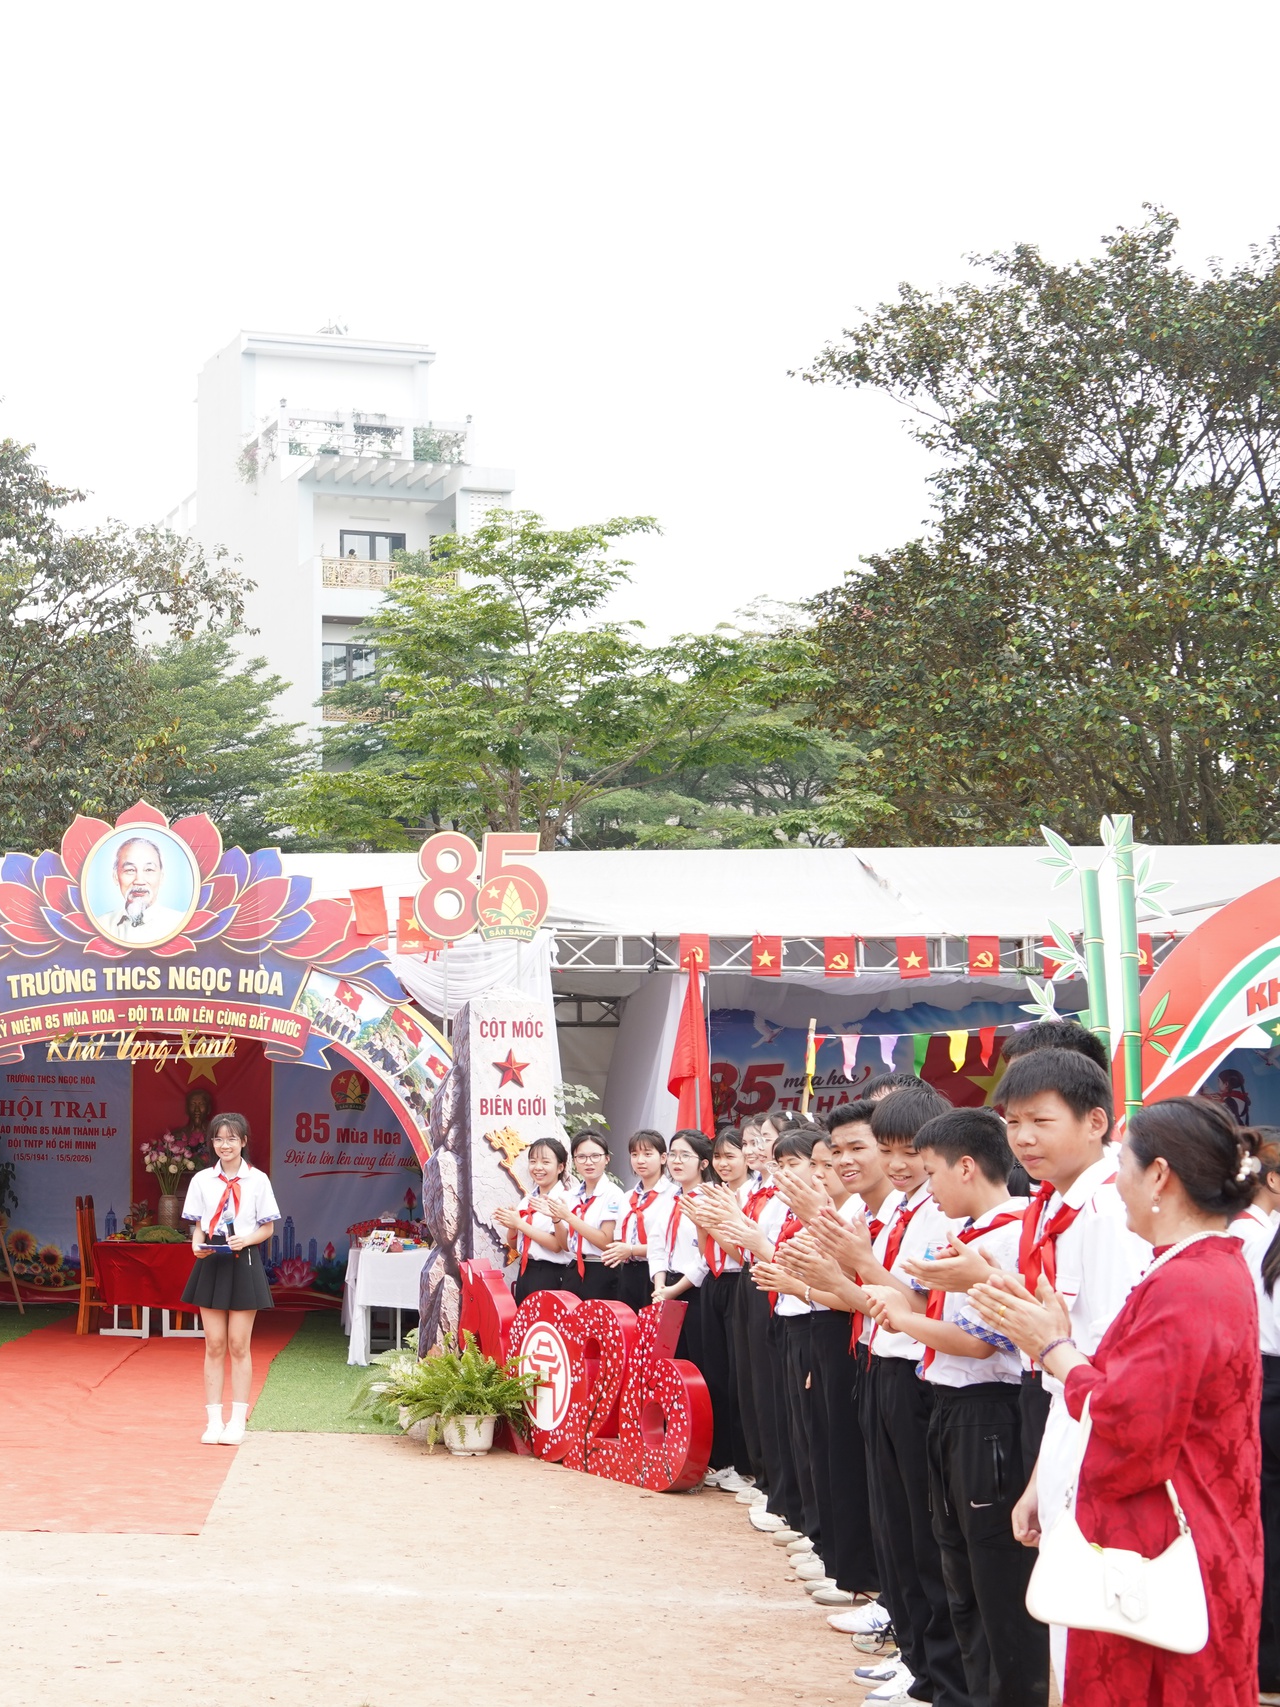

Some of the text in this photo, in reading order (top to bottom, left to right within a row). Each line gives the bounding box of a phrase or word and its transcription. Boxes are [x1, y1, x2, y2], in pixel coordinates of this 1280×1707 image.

[416, 832, 548, 941] 85
[508, 926, 533, 937] SÀNG
[6, 963, 285, 999] TRƯỜNG THCS NGỌC HÒA
[11, 1014, 43, 1036] NIỆM
[45, 1013, 61, 1029] 85
[63, 1008, 90, 1027] MÙA
[92, 1008, 116, 1024] HOA
[128, 1004, 147, 1025] ĐỘI
[150, 1007, 165, 1022] TA
[167, 1004, 190, 1022] LỚN
[192, 1005, 214, 1024] LÊN
[216, 1008, 247, 1028] CÙNG
[248, 1010, 271, 1031] ĐẤT
[271, 1018, 302, 1039] NƯỚC
[480, 1013, 544, 1042] CỘT MỐC
[46, 1025, 238, 1073] Khát Vọng Xanh
[6, 1072, 96, 1085] TRƯỜNG THCS NGỌC HÒA
[51, 1101, 108, 1123] TRẠI
[480, 1094, 546, 1116] BIÊN GIỚI
[13, 1124, 38, 1135] MỪNG
[39, 1125, 50, 1135] 85
[52, 1124, 70, 1135] NĂM
[73, 1124, 100, 1136] THÀNH
[101, 1125, 118, 1138] LẬP
[295, 1112, 402, 1145] 85 Mùa Hoa
[7, 1138, 22, 1149] ĐỘI
[23, 1139, 43, 1149] TNTP
[58, 1138, 73, 1149] CHÍ
[74, 1140, 97, 1150] MINH
[13, 1153, 49, 1162] (15/5/1941
[56, 1153, 92, 1163] 15/5/2026)
[284, 1149, 305, 1167] Đội
[306, 1153, 317, 1164] ta
[319, 1151, 334, 1165] lớn
[336, 1151, 352, 1165] lên
[353, 1151, 376, 1170] cùng
[378, 1151, 397, 1167] đất
